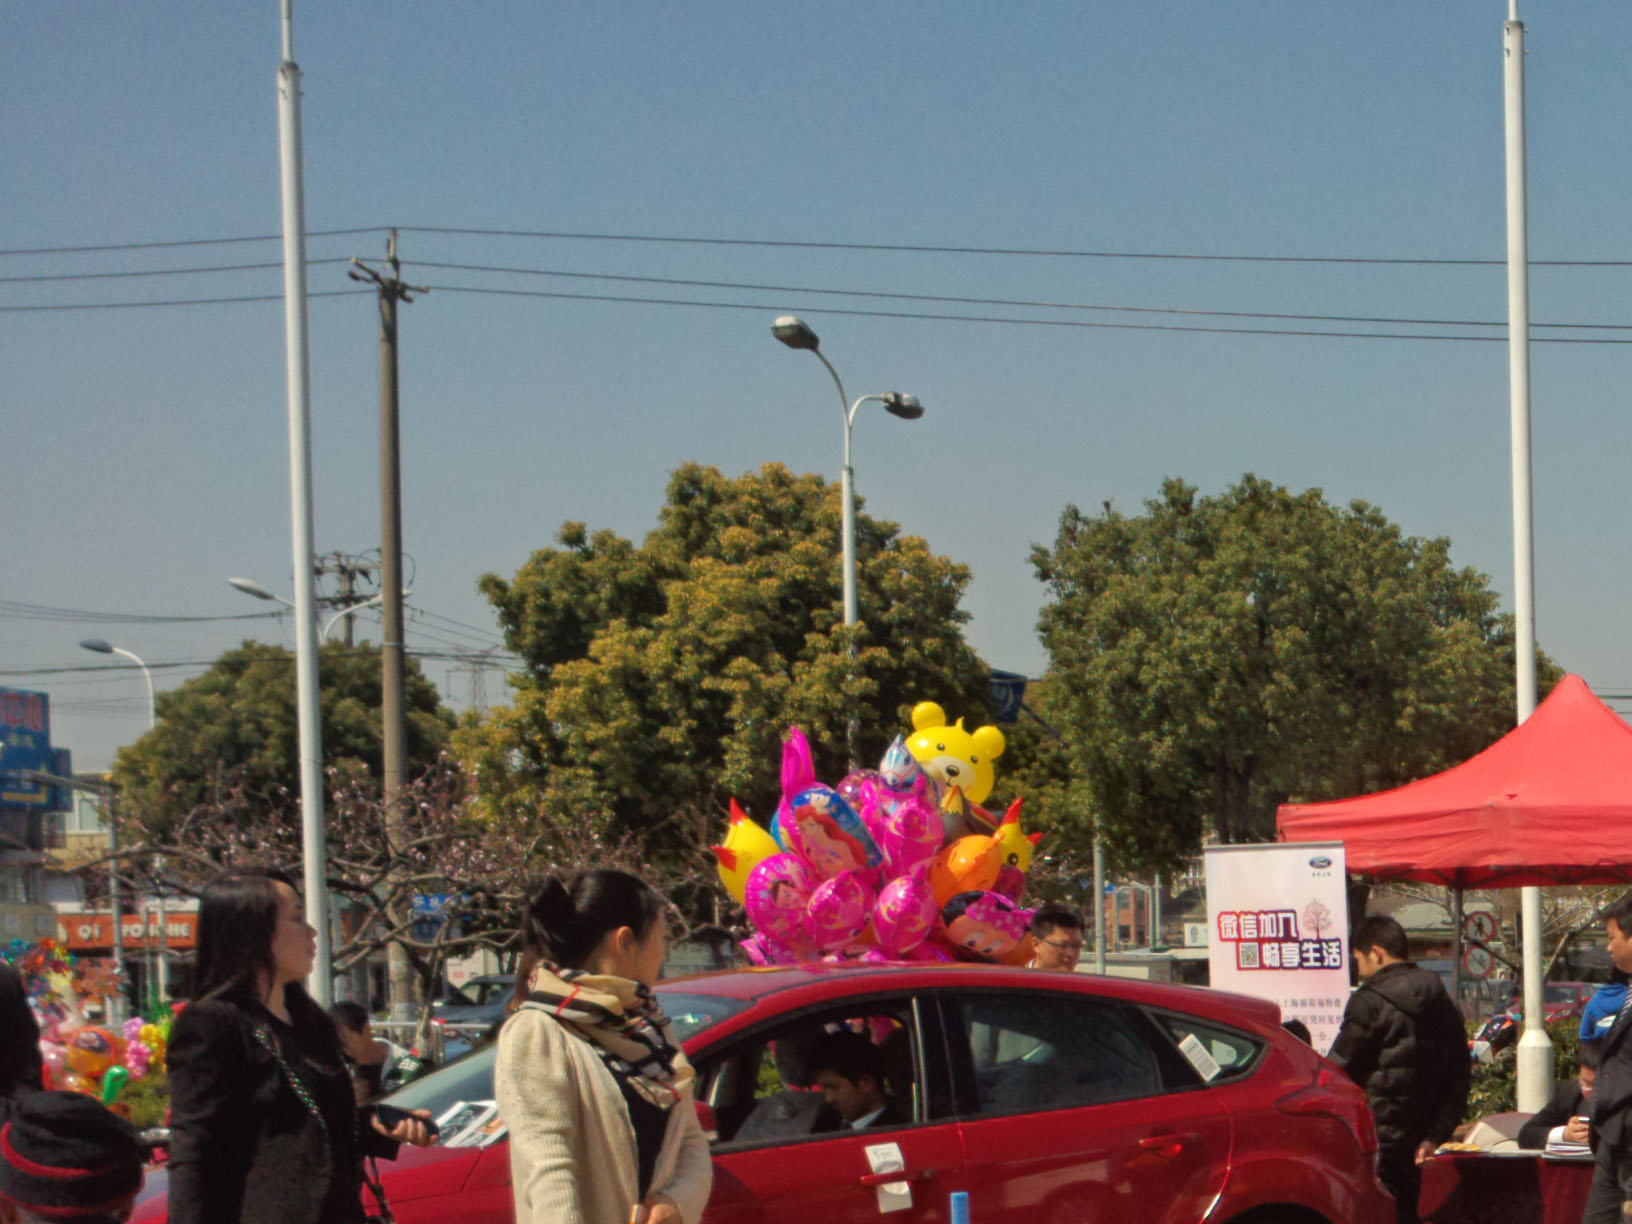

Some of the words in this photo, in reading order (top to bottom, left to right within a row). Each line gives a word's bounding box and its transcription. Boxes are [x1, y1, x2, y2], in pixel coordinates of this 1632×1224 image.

[1219, 912, 1298, 939] 微信加入
[1262, 941, 1341, 968] 畅享生活
